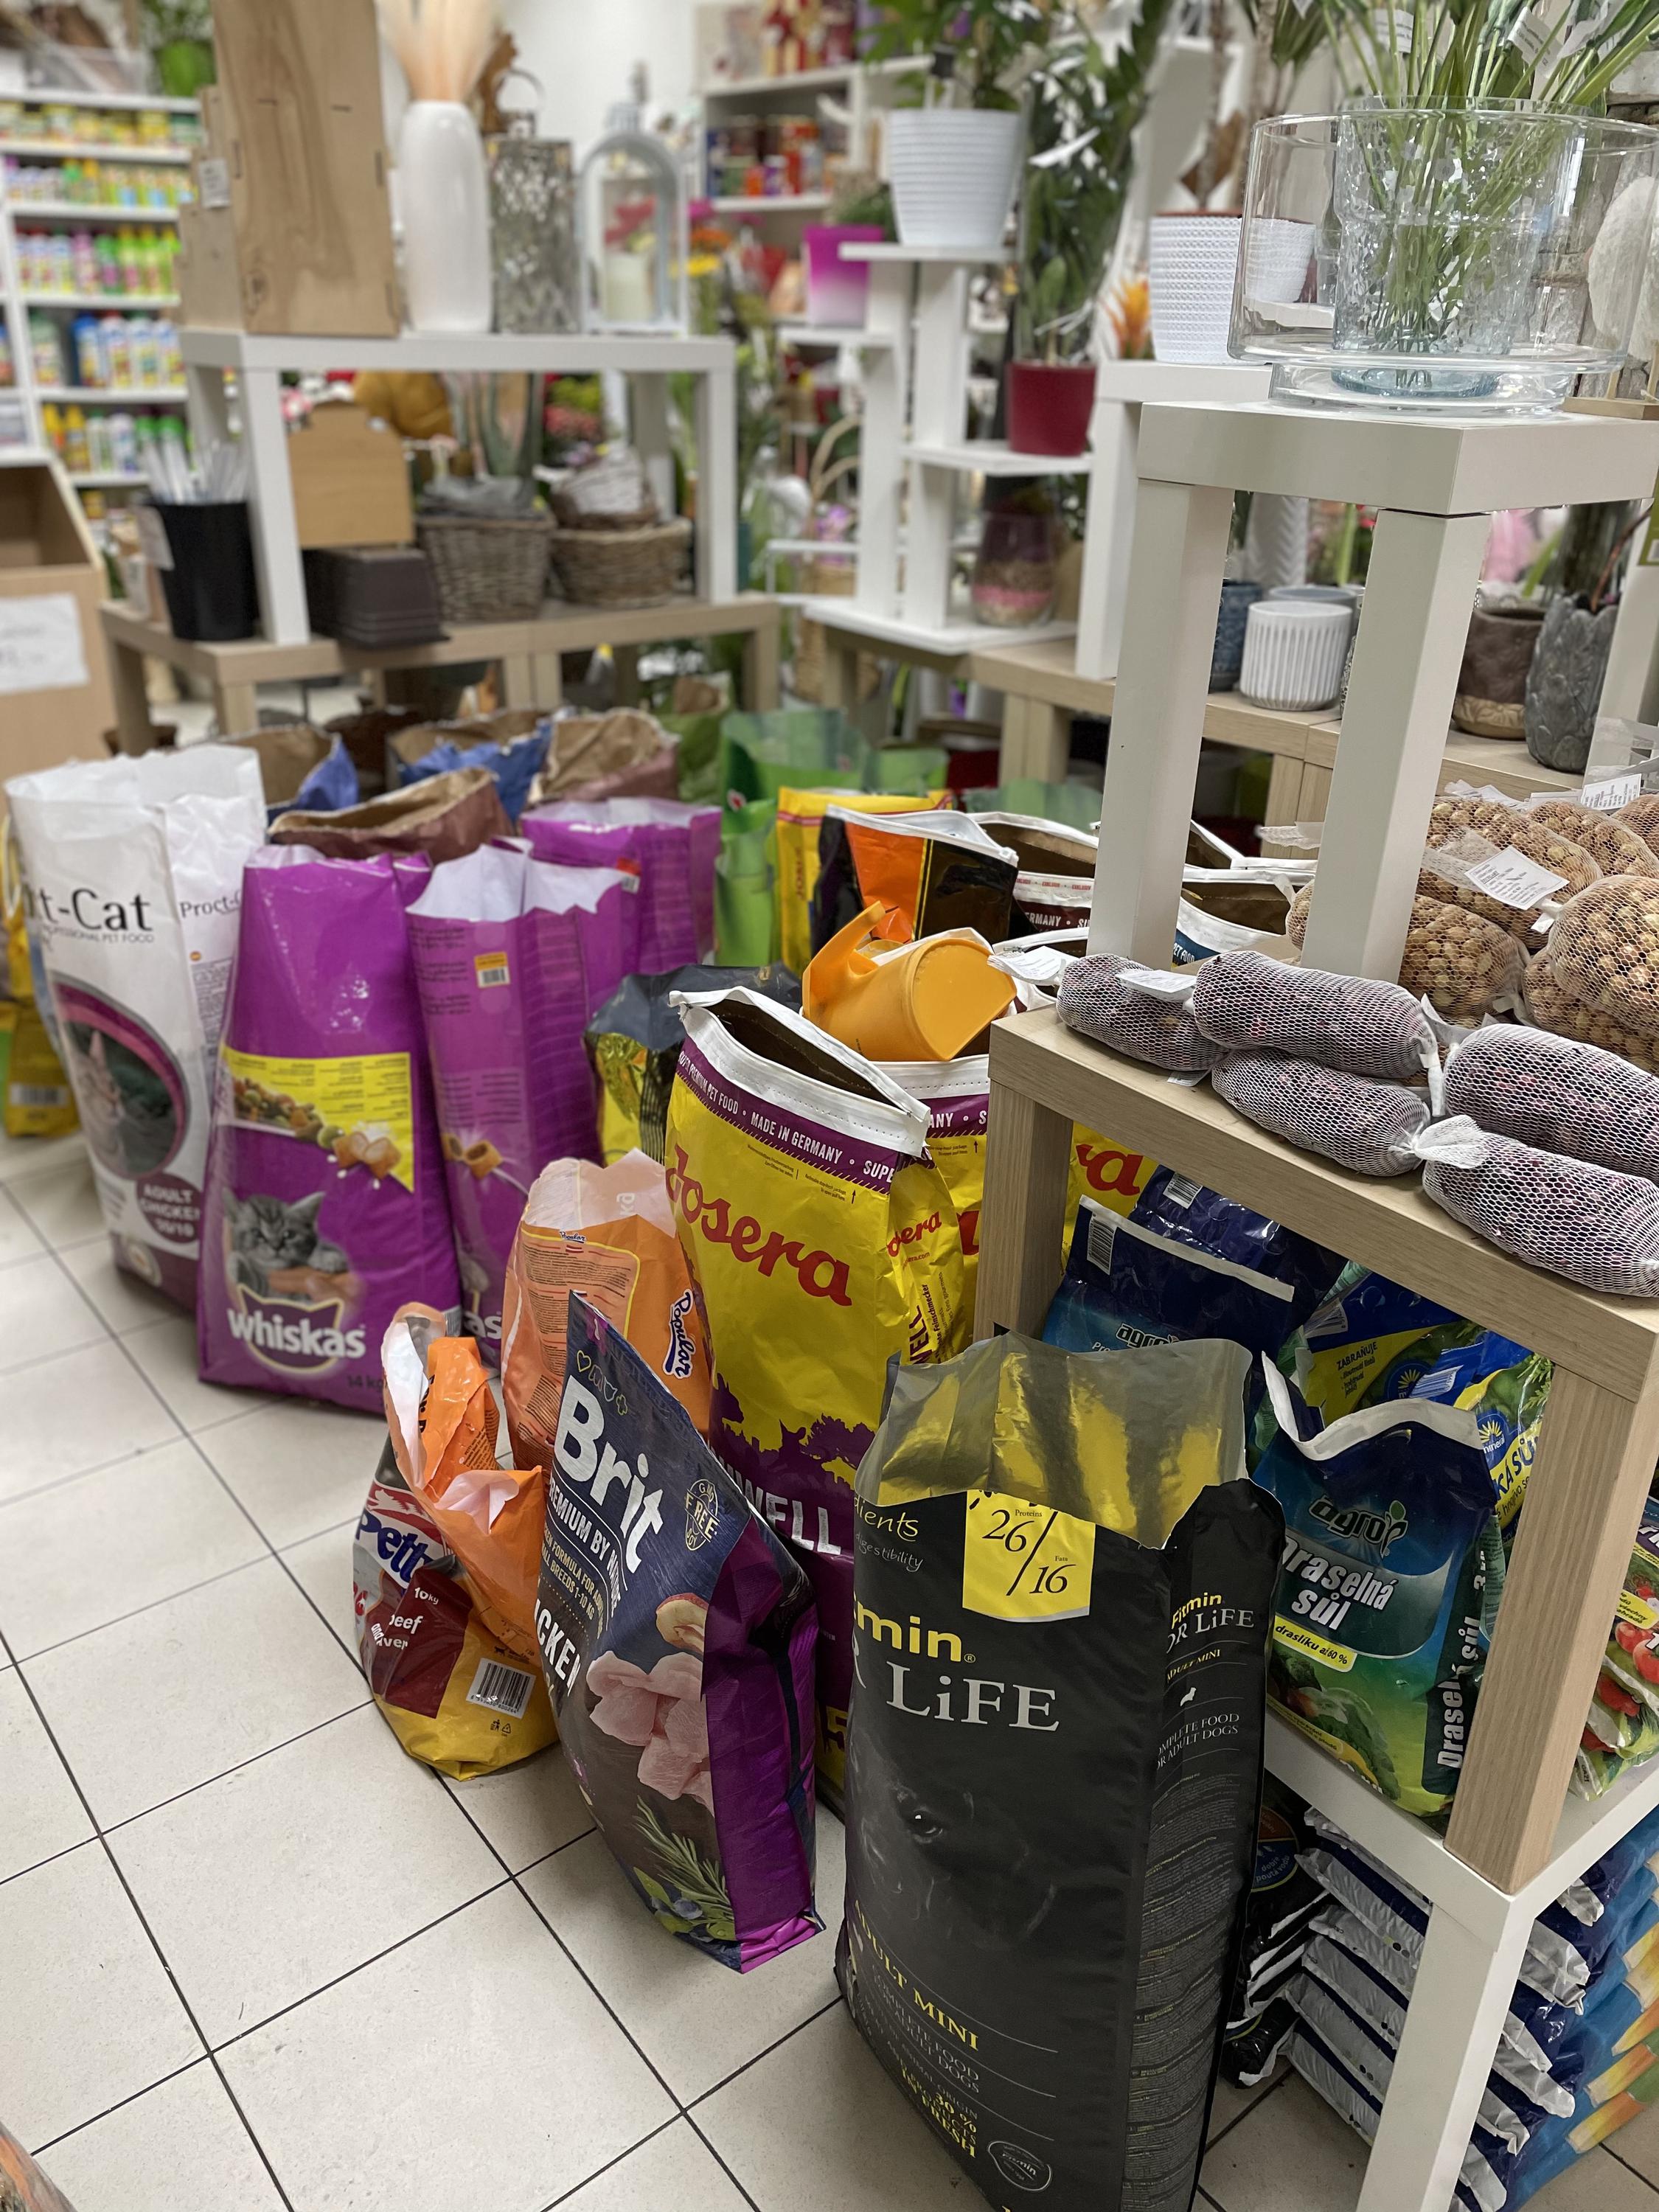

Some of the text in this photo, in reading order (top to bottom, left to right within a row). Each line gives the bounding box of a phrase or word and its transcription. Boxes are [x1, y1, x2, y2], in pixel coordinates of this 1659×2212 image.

[706, 1082, 719, 1102] PET
[717, 1092, 739, 1116] FOOD
[750, 1111, 776, 1135] MADE
[777, 1124, 790, 1142] IN
[791, 1131, 844, 1165] GERMANY
[863, 1160, 894, 1183] SUPE
[672, 1291, 695, 1377] Popular
[554, 1374, 664, 1574] Brit
[854, 1494, 919, 1543] dients
[1015, 1509, 1043, 1518] Proteins
[552, 1542, 581, 1582] FORMULA
[590, 1528, 611, 1562] BY
[549, 1557, 576, 1593] BREEDS
[1029, 1564, 1077, 1594] 16
[1171, 1592, 1222, 1630] Fitmin
[1194, 1608, 1255, 1634] LiFE
[1291, 1589, 1352, 1631] sůl
[854, 1599, 962, 1662] min
[1275, 1624, 1320, 1652] draslíku
[886, 1660, 1060, 1732] LiFE
[1201, 1712, 1240, 1729] FOOD
[1201, 1725, 1239, 1741] DOGS
[913, 1987, 979, 2051] MINI
